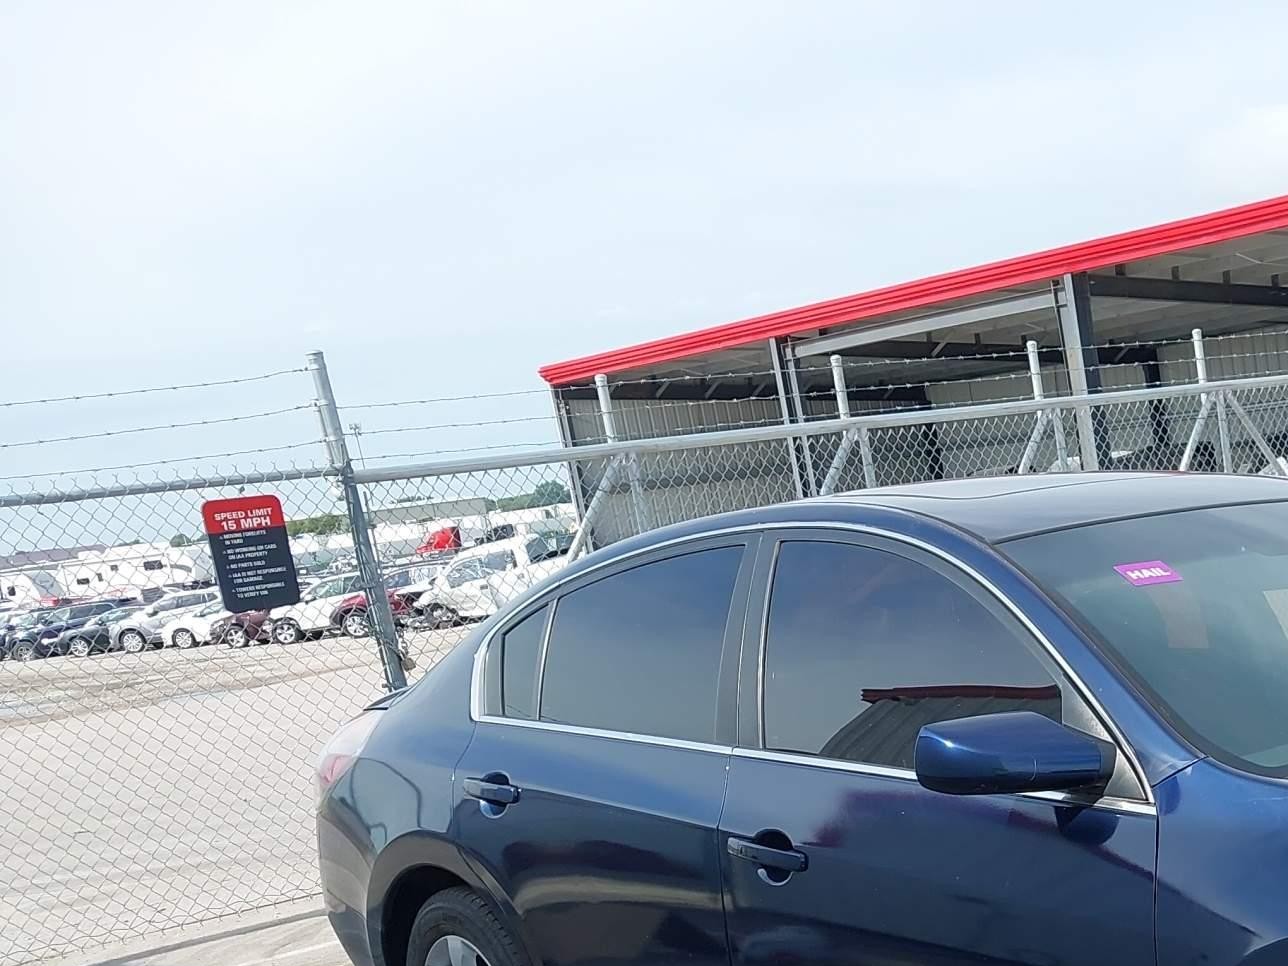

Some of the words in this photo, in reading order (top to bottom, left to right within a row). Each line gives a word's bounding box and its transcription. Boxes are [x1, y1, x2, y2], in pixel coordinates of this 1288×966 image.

[214, 511, 245, 521] SPEED
[247, 507, 272, 517] LIMIT
[221, 520, 237, 531] 15
[240, 516, 271, 529] MPH
[1126, 567, 1171, 580] HAIL
